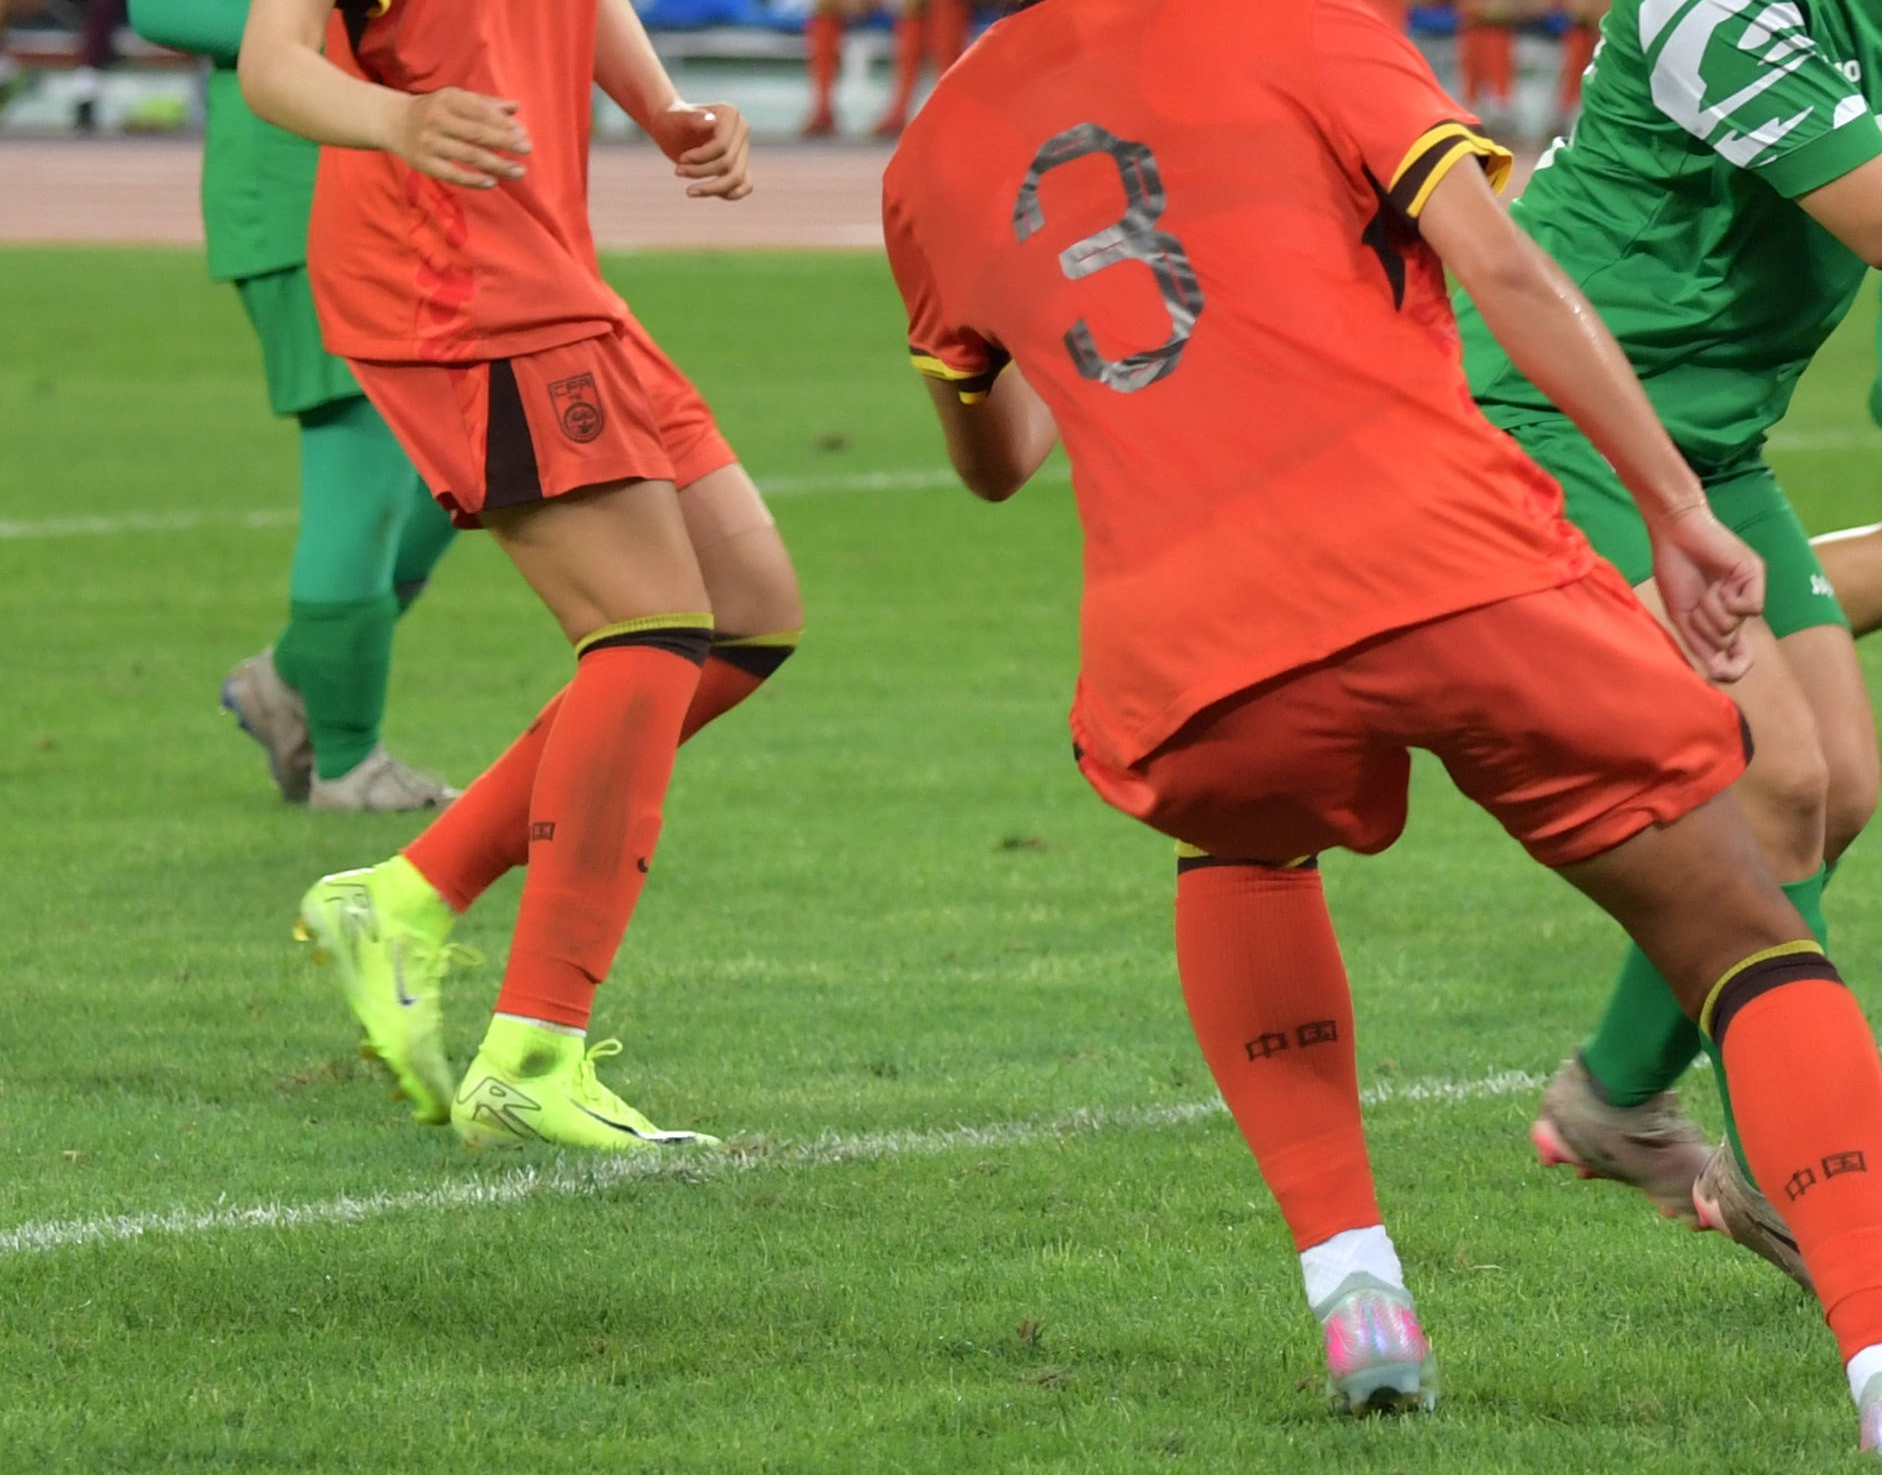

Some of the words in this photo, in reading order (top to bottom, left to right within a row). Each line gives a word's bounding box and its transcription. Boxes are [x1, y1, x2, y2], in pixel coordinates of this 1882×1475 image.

[1012, 121, 1205, 394] 3
[1245, 1020, 1339, 1062] 中国
[1784, 1151, 1868, 1202] 中国
